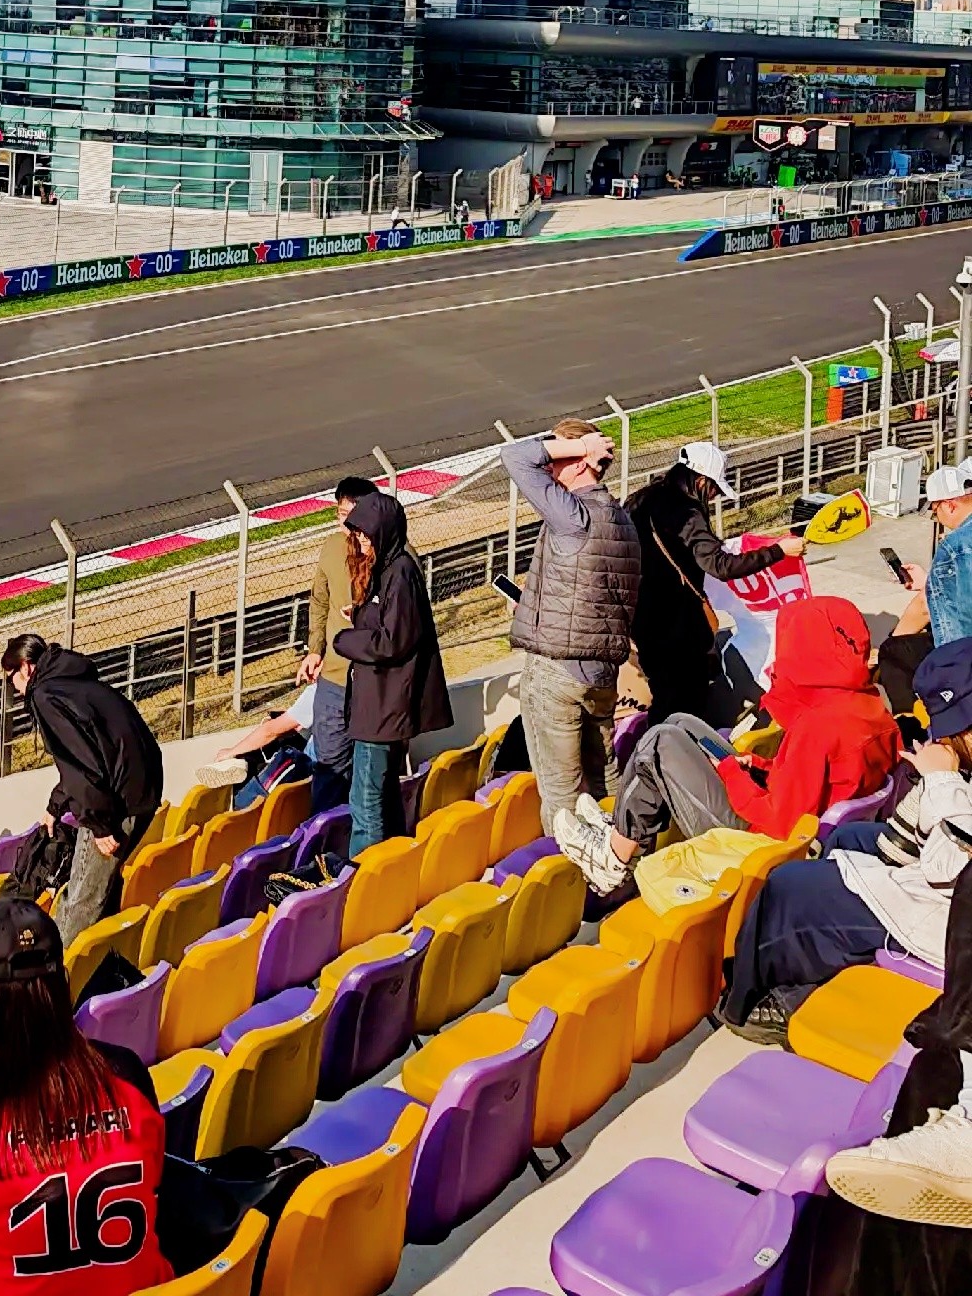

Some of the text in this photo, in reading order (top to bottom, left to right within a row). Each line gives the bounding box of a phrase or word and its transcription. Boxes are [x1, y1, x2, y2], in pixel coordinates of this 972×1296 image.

[413, 225, 461, 246] Heineken
[725, 229, 770, 253] Heineken
[810, 219, 848, 241] Heineken
[308, 234, 362, 256] Heineken
[188, 245, 249, 270] Heineken
[56, 258, 123, 286] Heineken
[8, 1159, 148, 1277] 16
